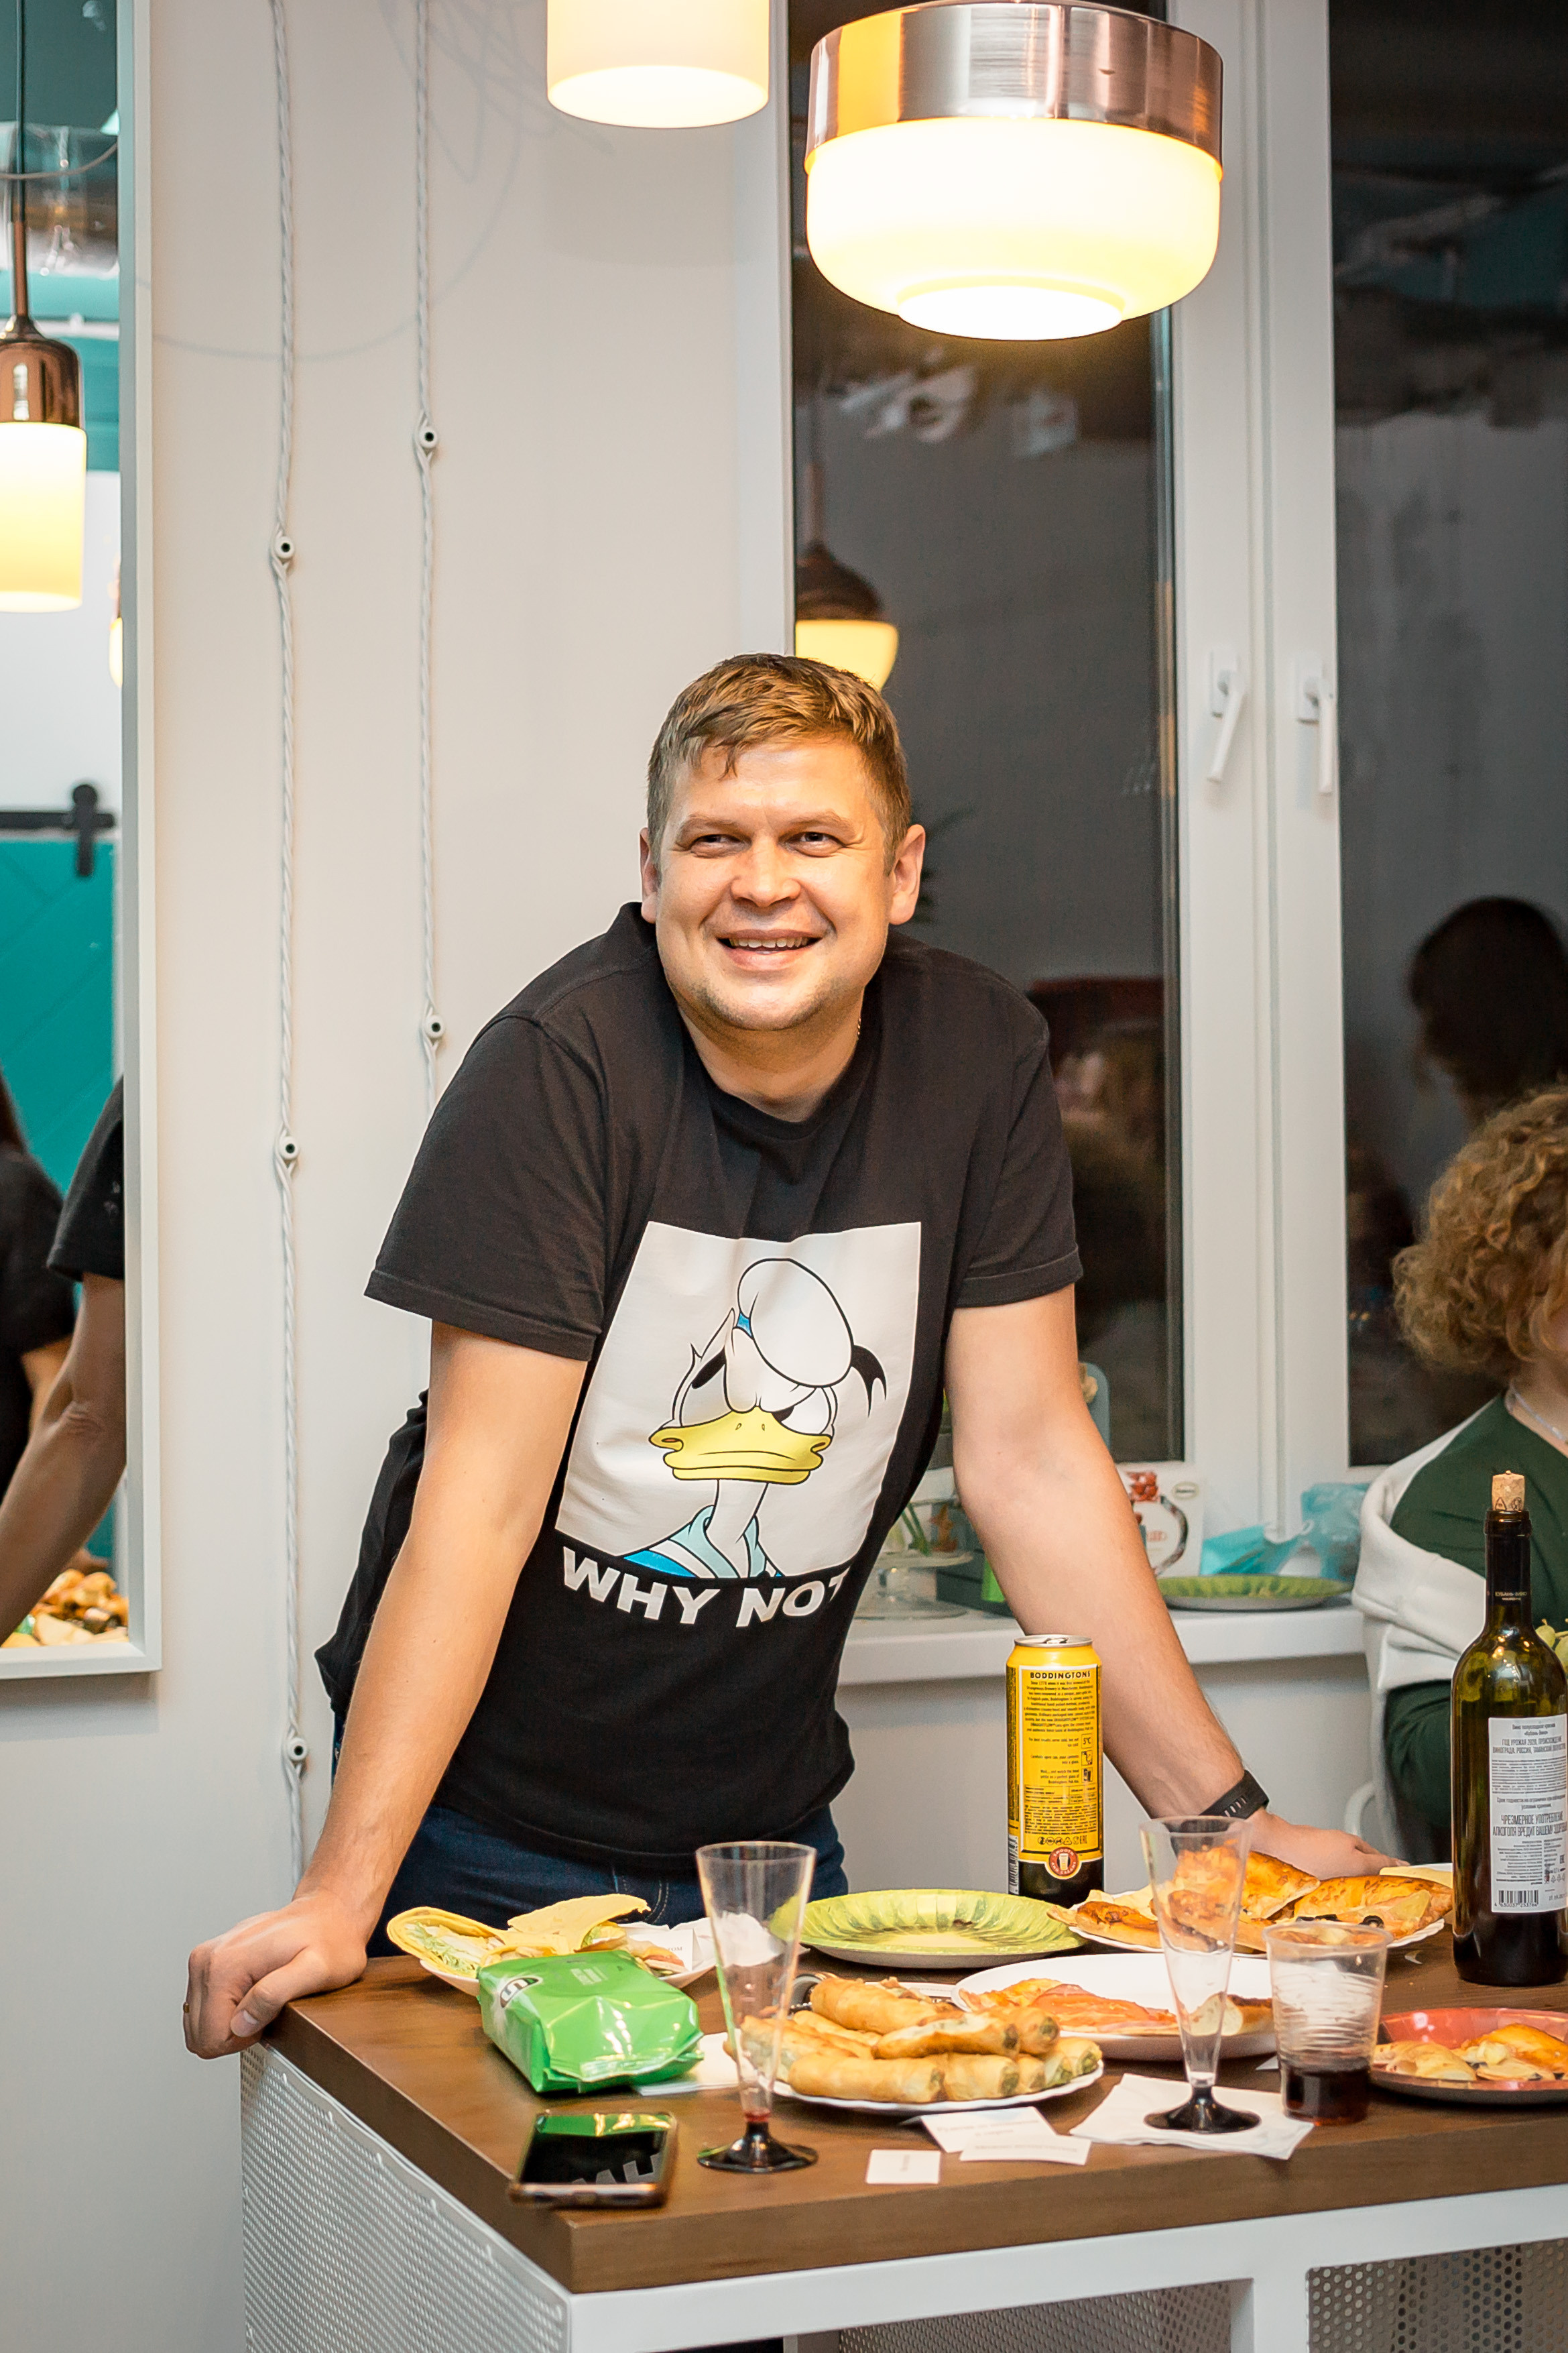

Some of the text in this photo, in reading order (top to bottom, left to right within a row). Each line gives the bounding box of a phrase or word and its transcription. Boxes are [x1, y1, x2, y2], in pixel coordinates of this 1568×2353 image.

[563, 1546, 850, 1627] WHY NOT
[1030, 1670, 1091, 1679] BODDINGTONS
[1501, 1814, 1534, 1825] ЧРЕЗМЕРНОЕ
[1492, 1826, 1516, 1837] АЛКОГОЛЯ
[1517, 1826, 1535, 1837] ВРЕДИТ
[1536, 1824, 1553, 1836] ВАШЕМУ
